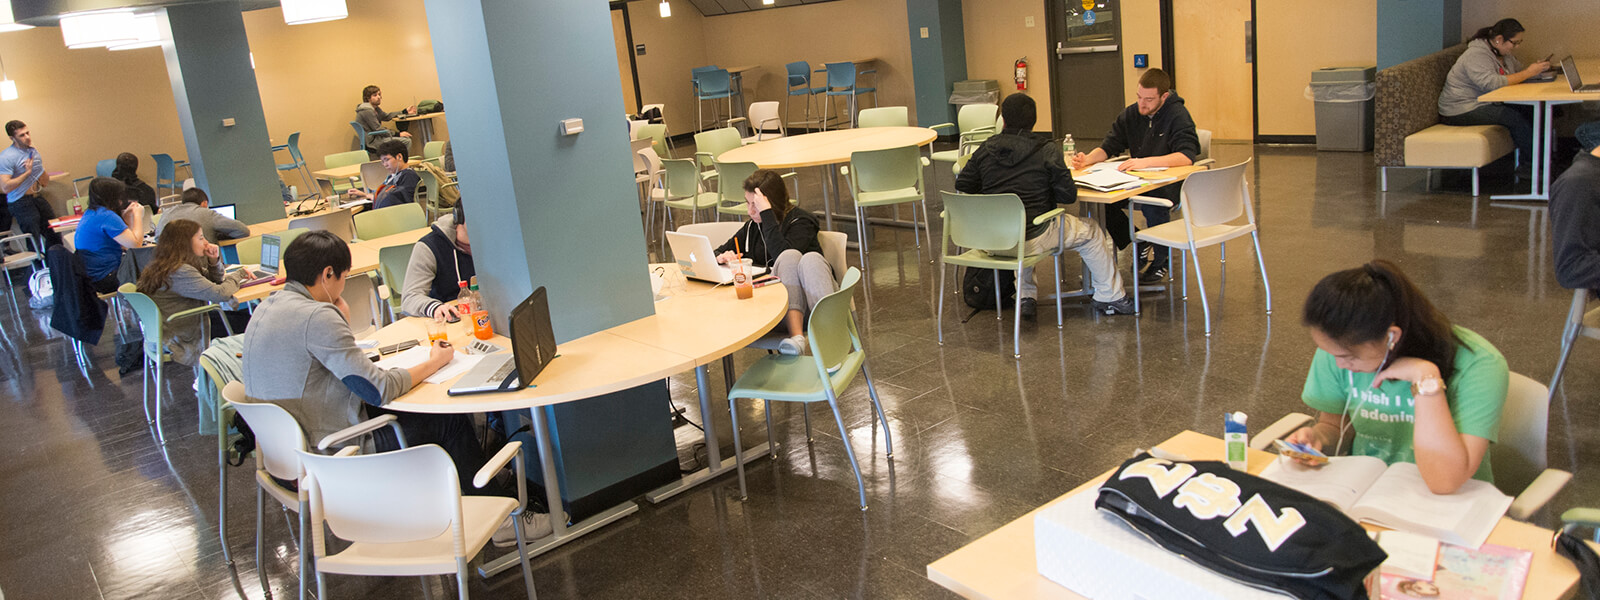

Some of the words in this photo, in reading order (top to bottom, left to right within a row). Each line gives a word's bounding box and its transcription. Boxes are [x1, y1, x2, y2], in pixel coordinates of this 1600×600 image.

[1352, 387, 1358, 398] I
[1395, 395, 1401, 407] I
[1360, 408, 1415, 424] adenin
